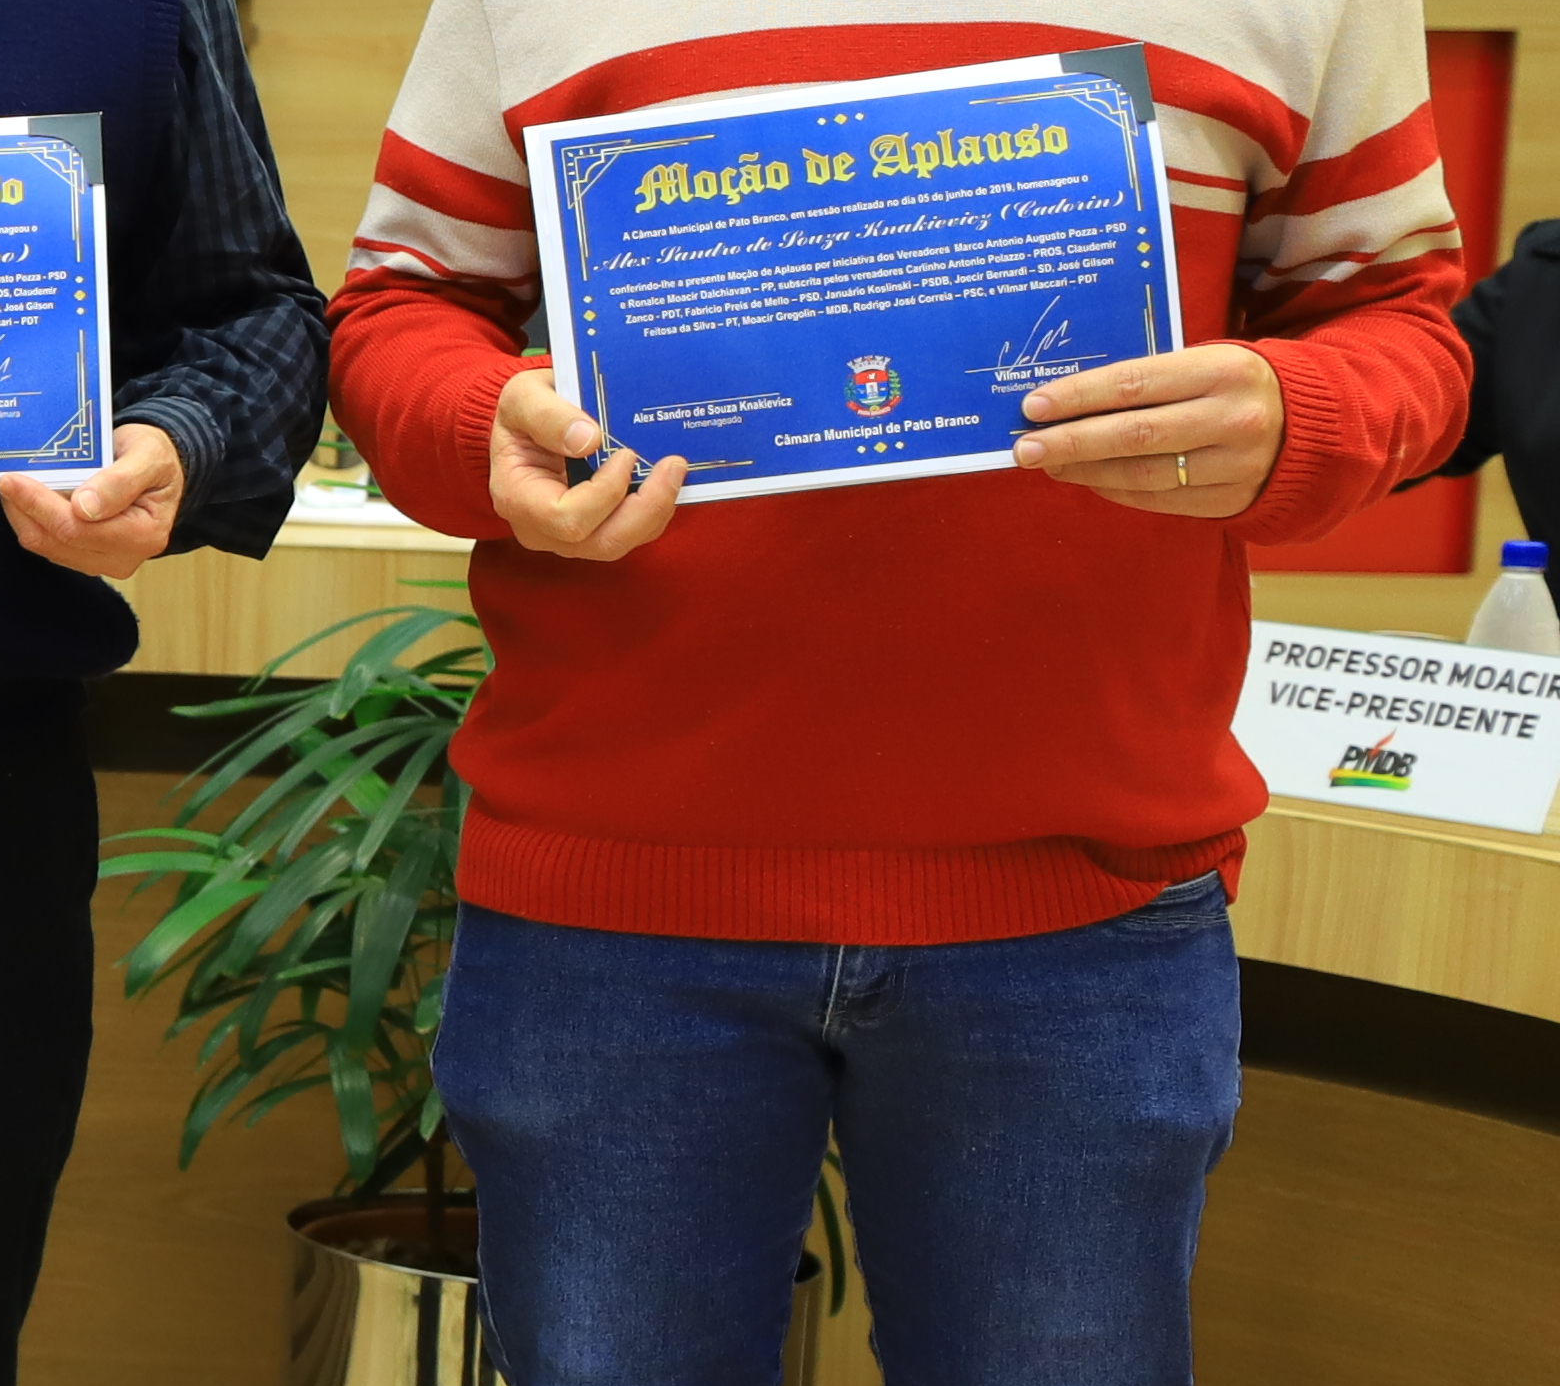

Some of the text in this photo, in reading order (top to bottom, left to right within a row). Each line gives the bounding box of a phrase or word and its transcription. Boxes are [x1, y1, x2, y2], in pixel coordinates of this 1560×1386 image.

[634, 122, 1071, 214] Moção de Aplauso
[622, 231, 631, 241] A
[631, 228, 668, 240] Câmara
[668, 220, 714, 236] Municipal
[714, 220, 728, 230] de
[728, 217, 751, 228] Pato
[751, 213, 789, 225] Branco,
[790, 211, 806, 220] em
[806, 205, 841, 218] sessão
[842, 199, 885, 214] realizada
[886, 198, 900, 208] no
[900, 195, 917, 206] dia
[917, 192, 931, 204] 05
[930, 191, 944, 202] de
[944, 188, 974, 203] junho
[974, 186, 988, 196] de
[1016, 175, 1081, 191] homenageou
[1080, 174, 1089, 183] o
[994, 361, 1082, 382] Vilmar Maccari
[774, 414, 980, 447] Câmara Municipal de Pato Branco
[1265, 640, 1560, 700] PROFESSOR MOACIR
[1269, 681, 1541, 740] VICE-PRESIDENTE
[1337, 744, 1418, 778] PMDB
